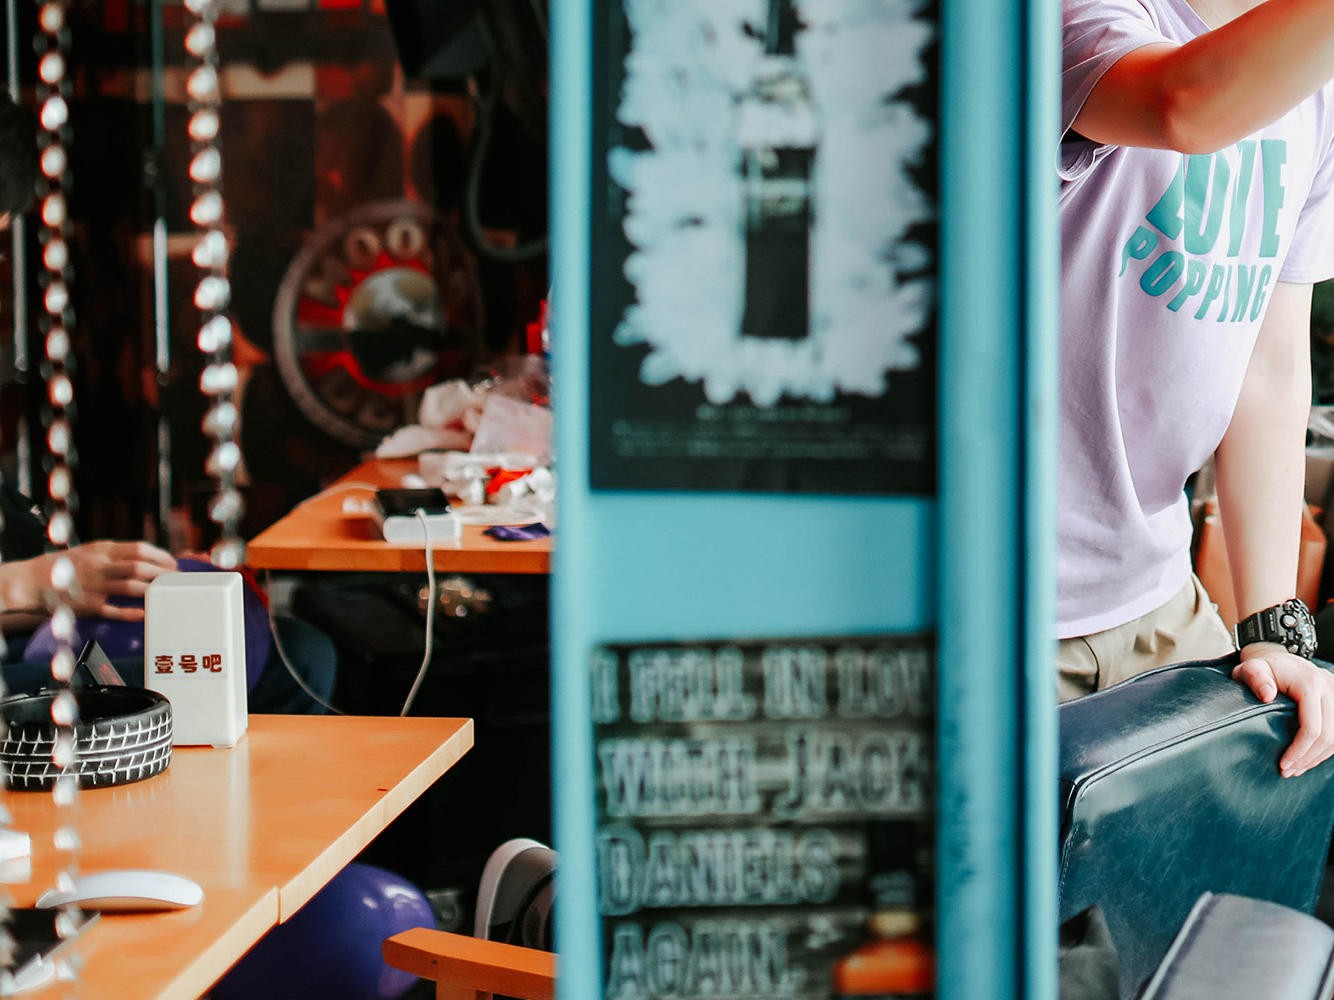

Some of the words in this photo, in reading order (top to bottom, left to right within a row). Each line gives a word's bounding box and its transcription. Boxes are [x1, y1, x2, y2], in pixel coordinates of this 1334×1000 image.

[1145, 139, 1287, 258] LOVE
[1118, 225, 1272, 323] POPPING
[154, 654, 223, 674] 壹号吧
[762, 645, 828, 719] IN
